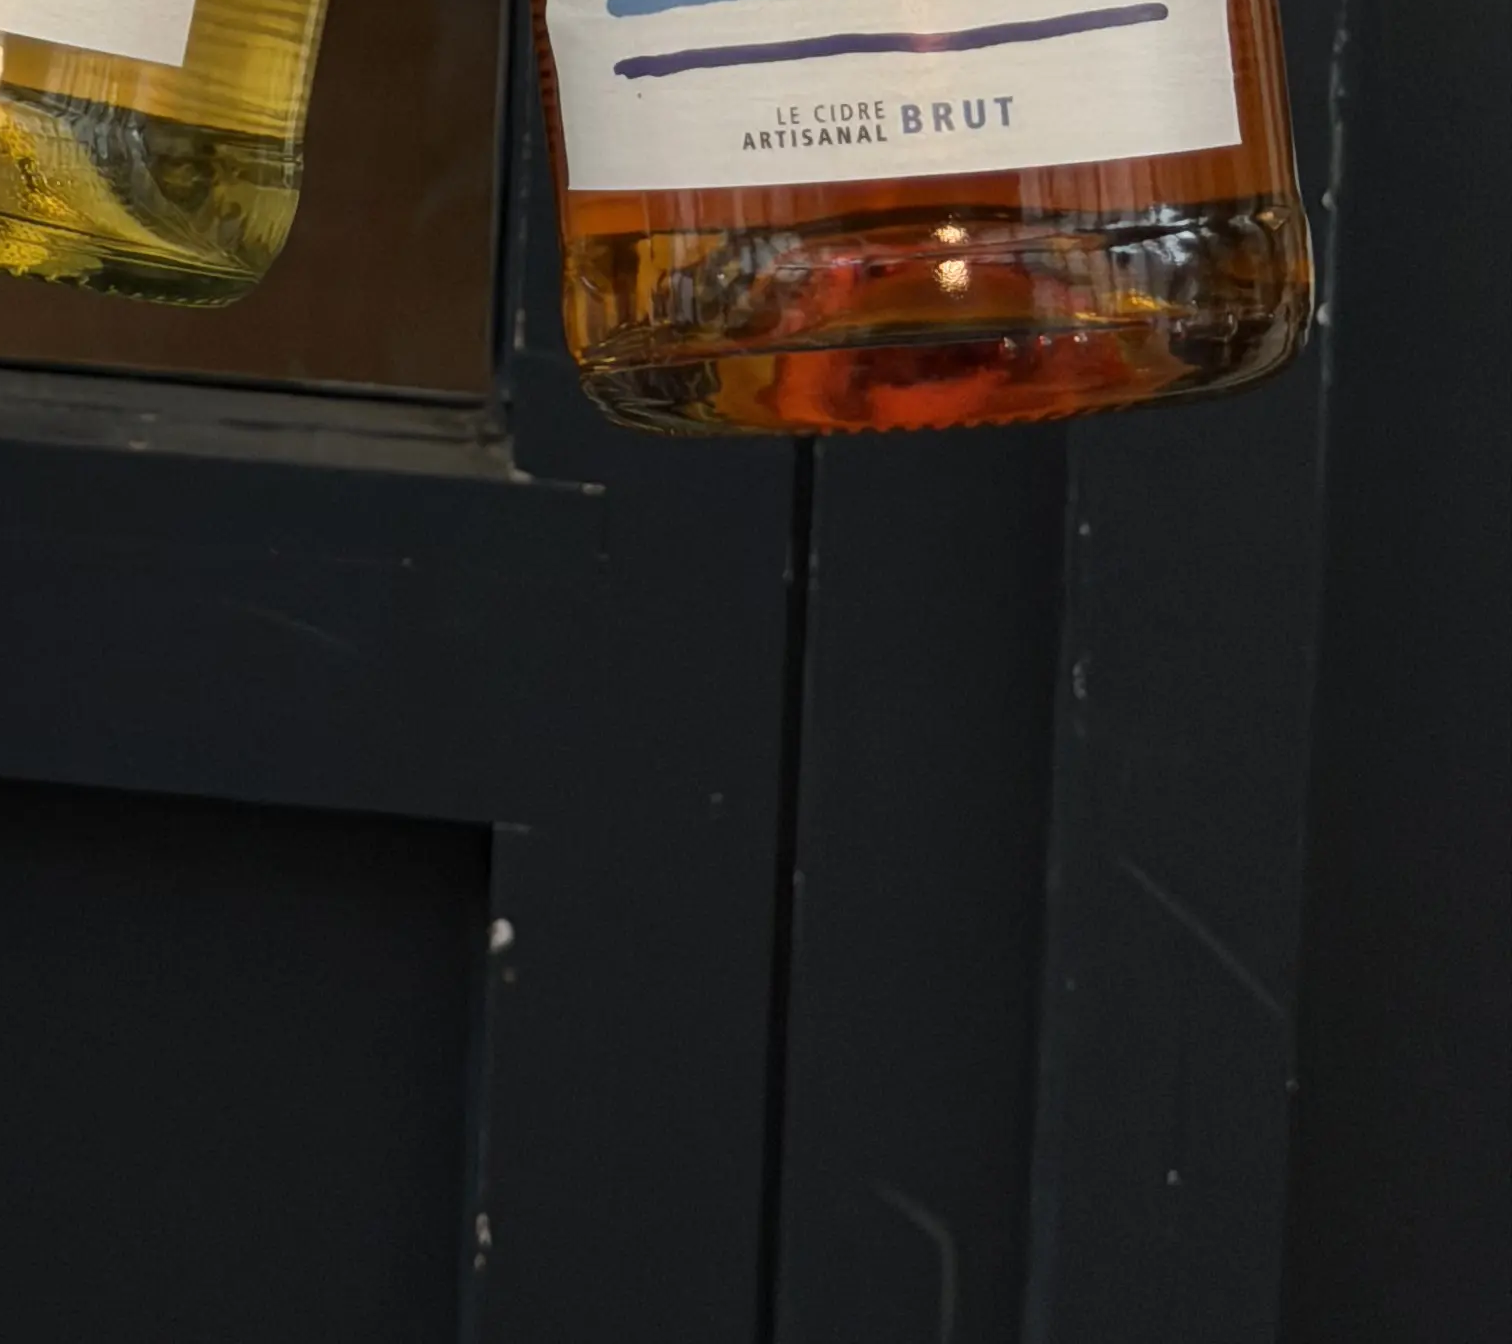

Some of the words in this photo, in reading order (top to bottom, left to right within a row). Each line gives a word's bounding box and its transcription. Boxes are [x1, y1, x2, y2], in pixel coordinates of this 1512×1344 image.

[776, 106, 800, 127] LE
[814, 100, 887, 124] CIDRE
[900, 96, 1014, 134] BRUT
[742, 124, 888, 151] ARTISANAL
